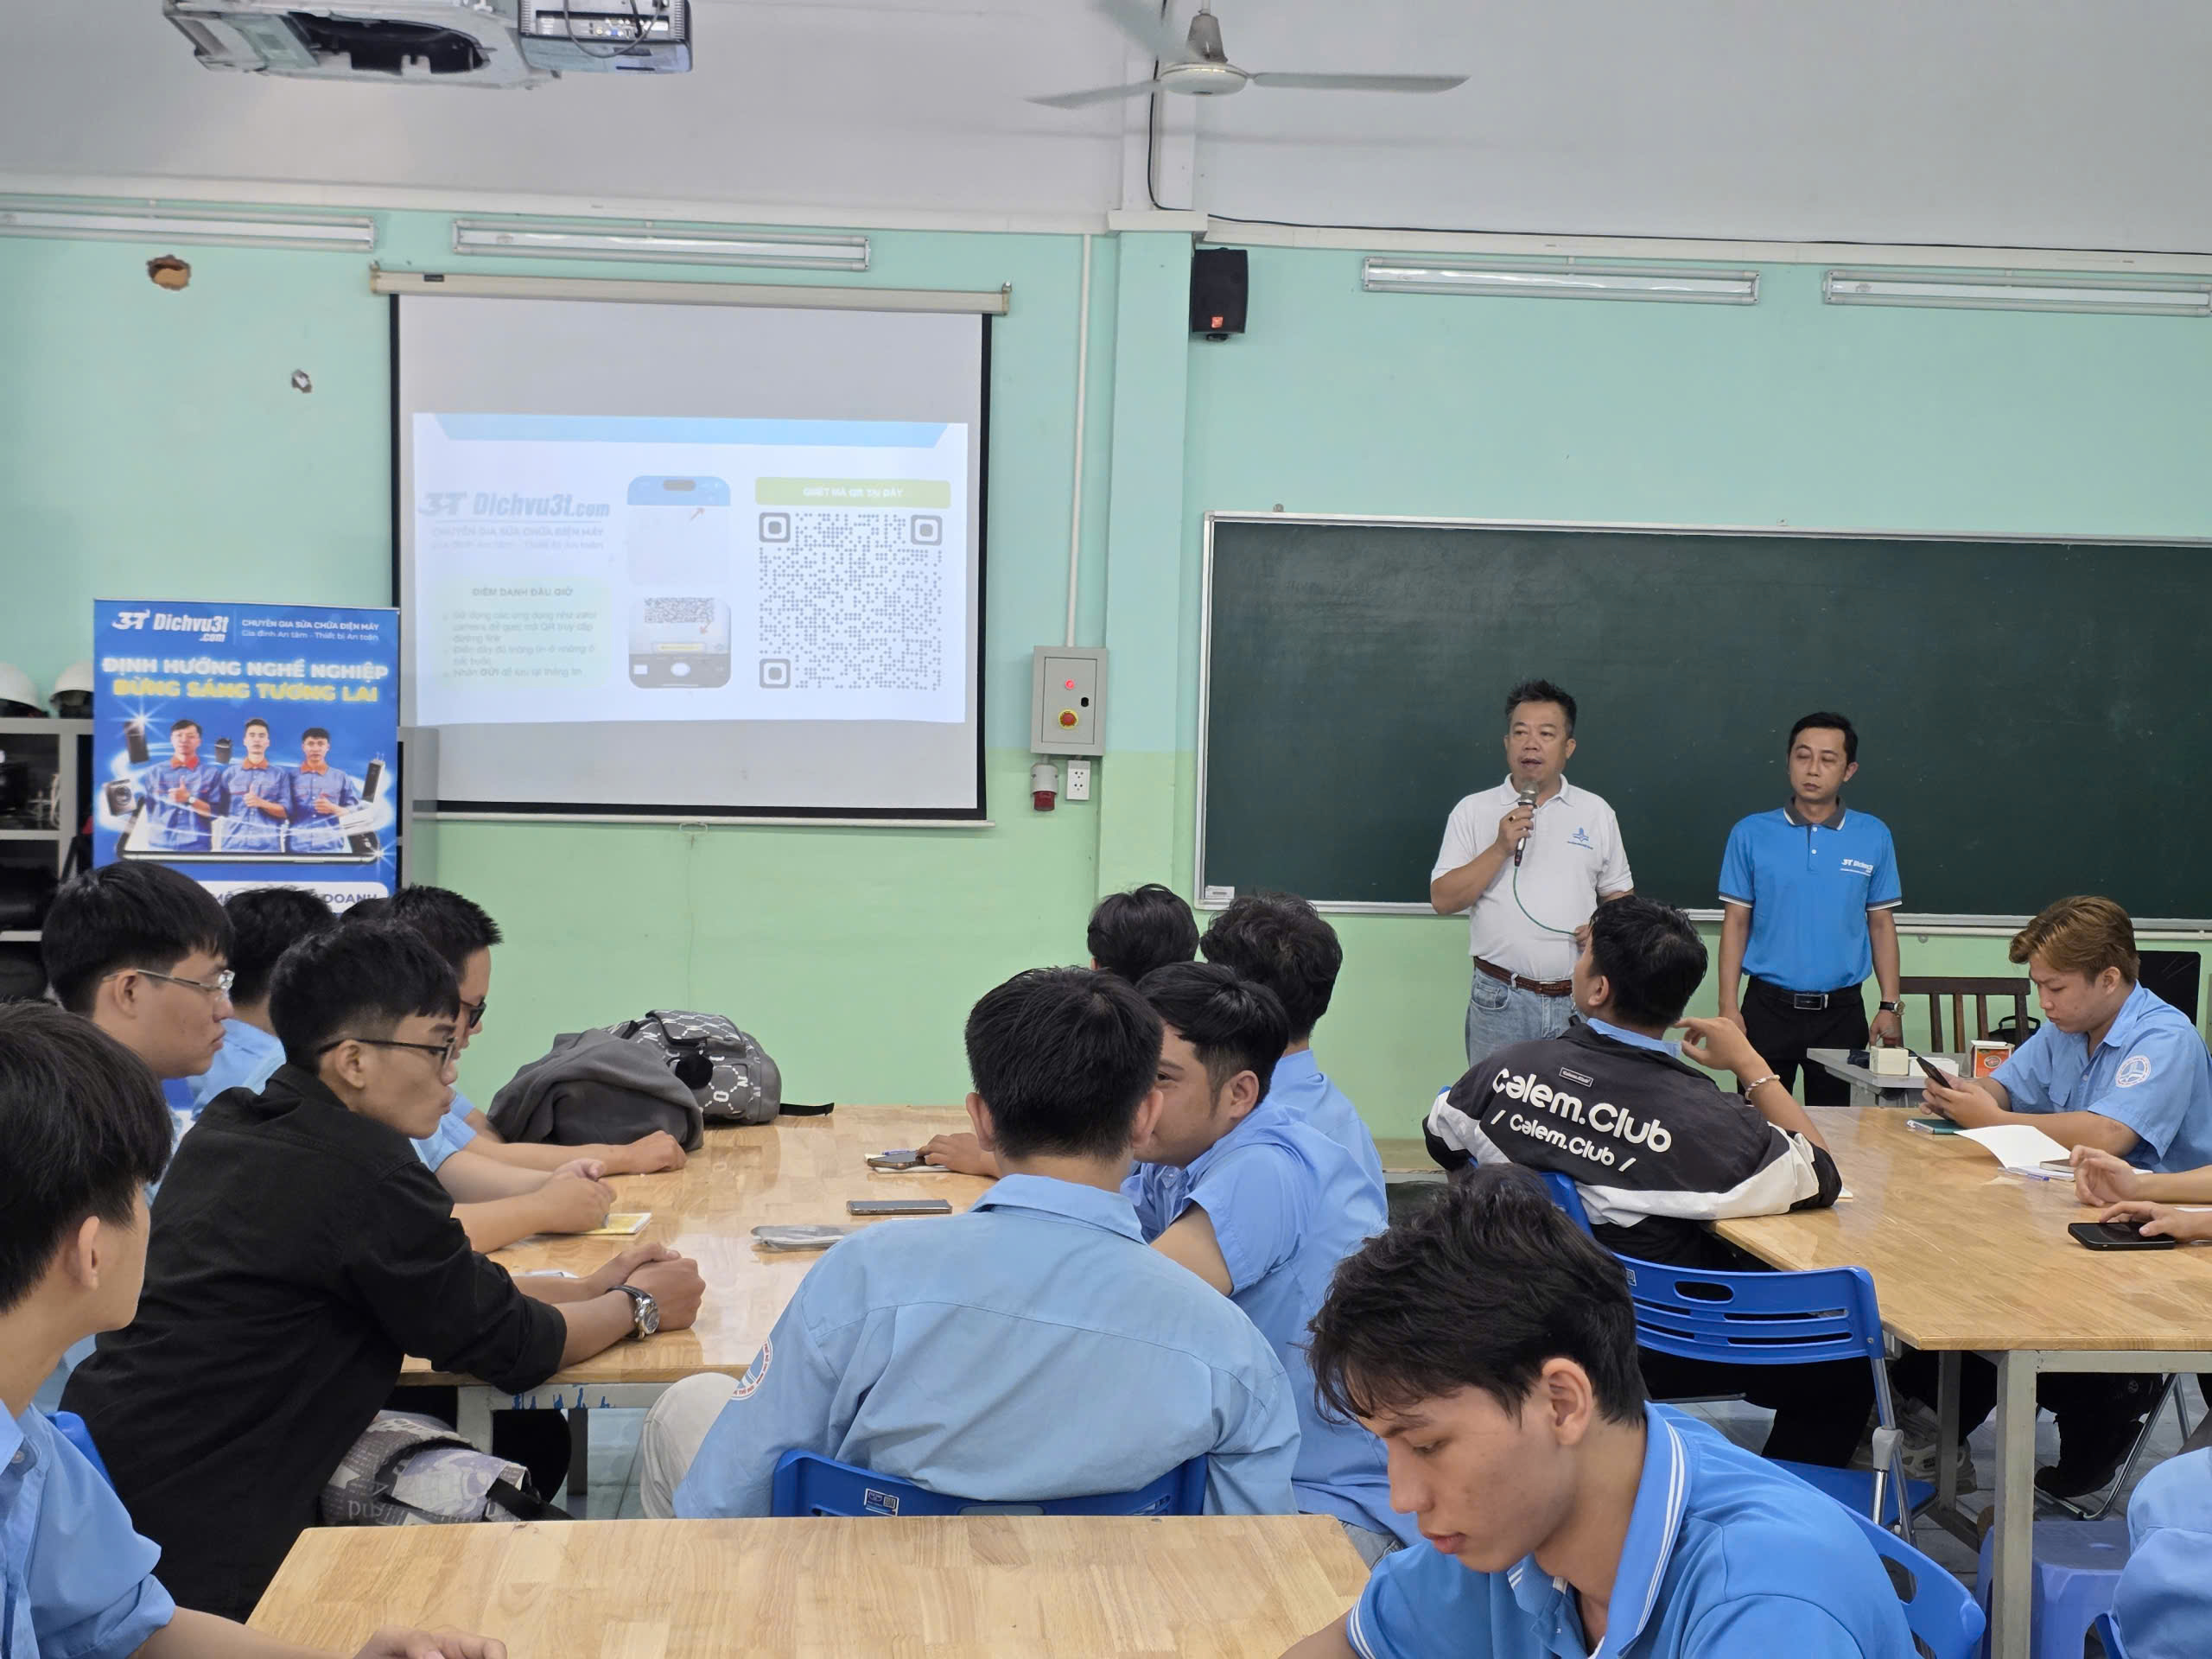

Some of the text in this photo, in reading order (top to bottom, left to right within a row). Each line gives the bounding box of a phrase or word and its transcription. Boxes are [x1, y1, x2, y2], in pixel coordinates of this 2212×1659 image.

[153, 613, 229, 632] Dichvu3t
[242, 618, 276, 628] CHUYÊN
[278, 620, 293, 629] GIA
[340, 621, 359, 632] ĐIỆN
[361, 621, 379, 631] MÁY
[199, 632, 226, 643] .com
[101, 658, 157, 676] ĐỊNH
[311, 661, 388, 683] NGHIỆP
[112, 676, 378, 702] BỪNG SÁNG TƯƠNG LAI
[1492, 1068, 1672, 1153] Calem.Club
[1510, 1113, 1615, 1166] Calem.Club
